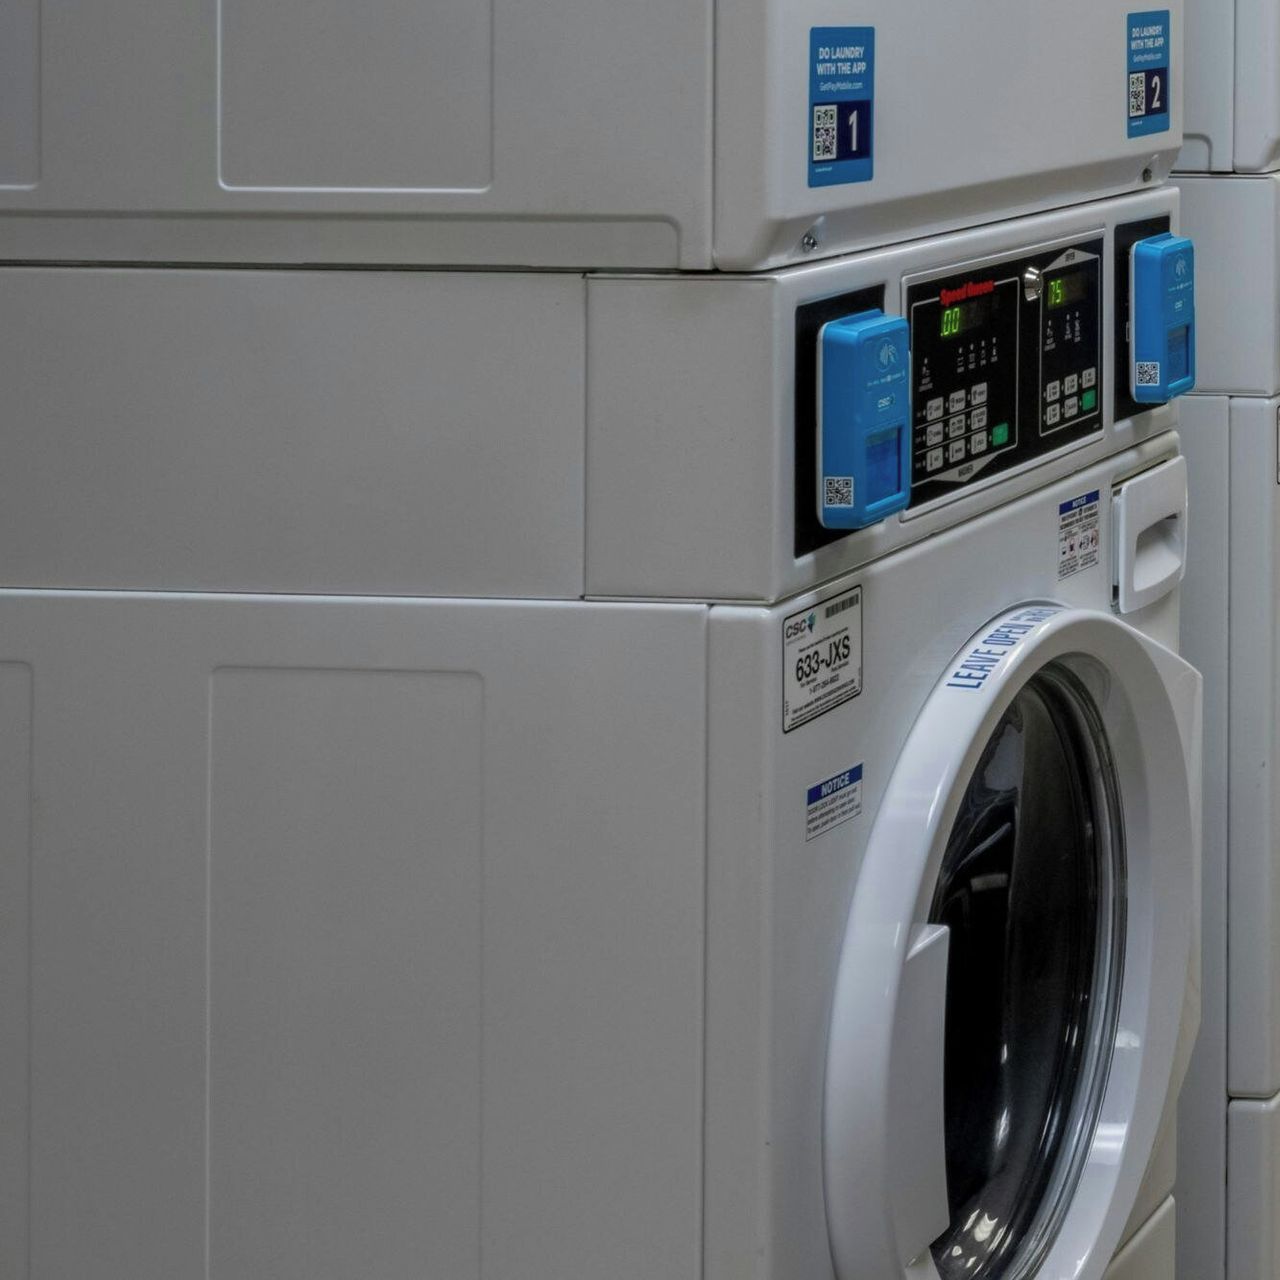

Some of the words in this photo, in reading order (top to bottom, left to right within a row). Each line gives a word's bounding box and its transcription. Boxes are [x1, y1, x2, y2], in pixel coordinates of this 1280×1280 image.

[1131, 39, 1144, 50] WITH
[1144, 38, 1154, 49] THE
[1154, 36, 1164, 48] APP
[1132, 27, 1140, 38] DO
[1140, 25, 1163, 37] LAUNDRY
[819, 47, 830, 60] DO
[831, 46, 865, 60] LAUNDRY
[817, 63, 836, 76] WITH
[837, 62, 851, 75] THE
[852, 61, 866, 74] APP
[1151, 75, 1160, 109] 2
[849, 109, 858, 152] 1
[786, 618, 807, 639] CSC
[796, 634, 851, 682] 633-JXS
[946, 648, 1008, 689] LEAVE
[982, 622, 1035, 646] OPEN
[821, 771, 850, 797] NOTICE
